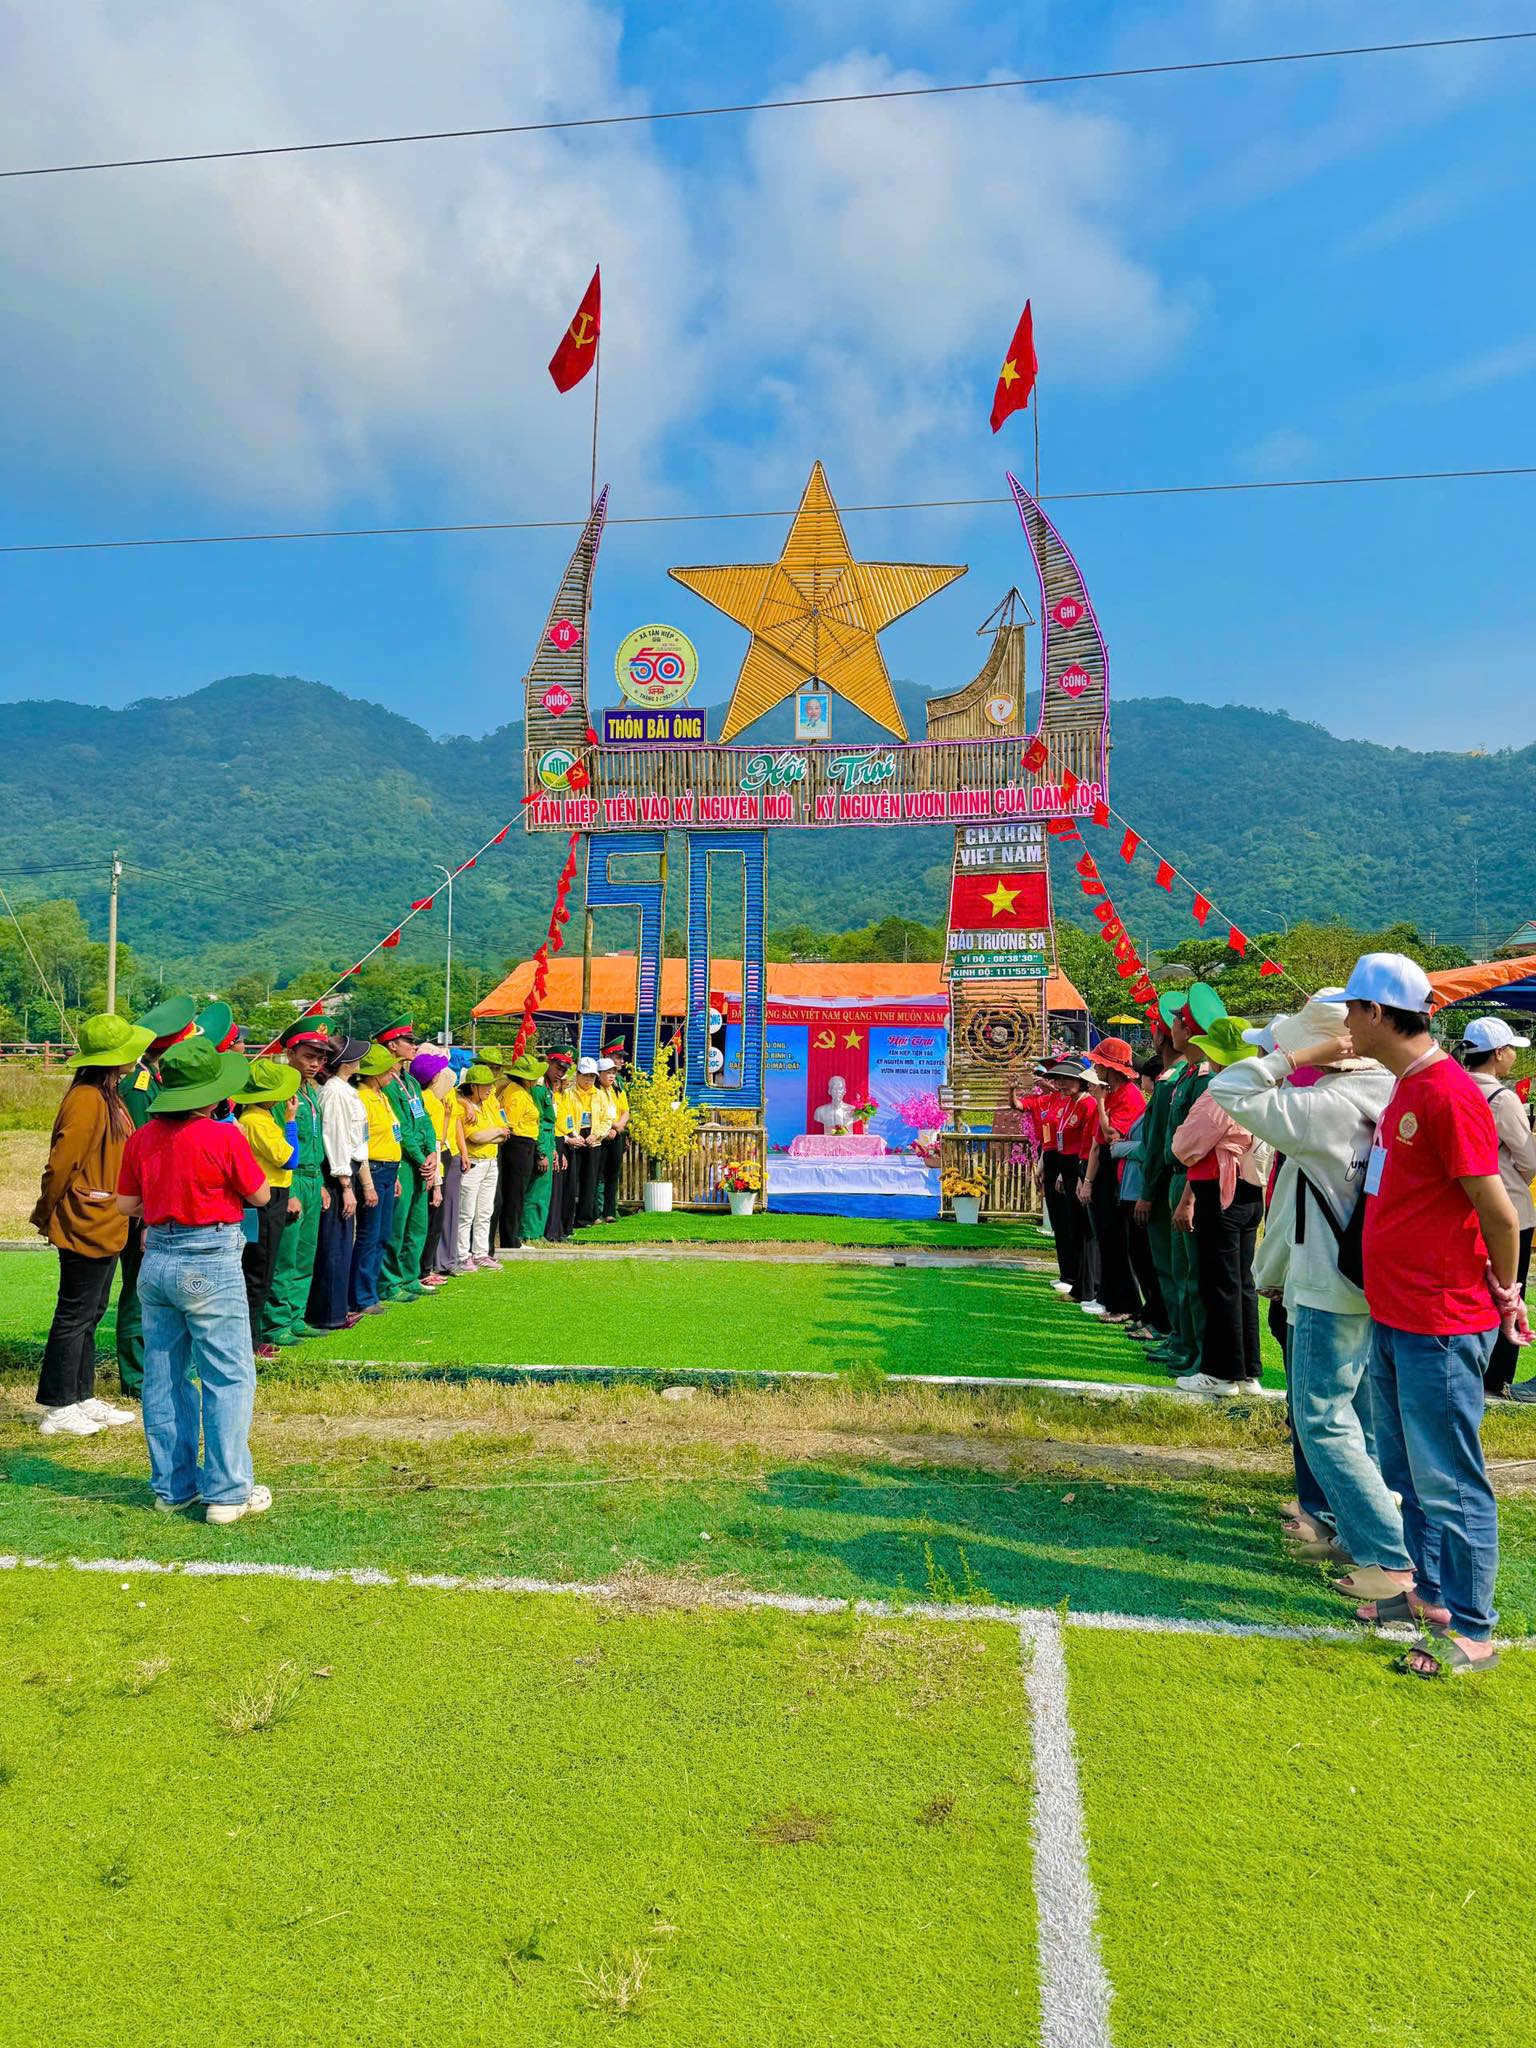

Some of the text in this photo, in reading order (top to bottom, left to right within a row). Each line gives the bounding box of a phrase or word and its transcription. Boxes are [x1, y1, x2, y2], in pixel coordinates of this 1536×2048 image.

[1060, 606, 1076, 619] GHI
[1062, 673, 1087, 688] CÔNG
[545, 690, 569, 706] QUỐC
[608, 713, 702, 739] THÔN BÃI ÔNG
[740, 747, 896, 791] Hội Trại
[532, 795, 562, 825] TÂN
[565, 794, 600, 829] HIỆP
[604, 791, 637, 822] TIẾN
[641, 792, 670, 821] VÀO
[674, 789, 694, 821] KỶ
[699, 792, 759, 821] NGUYÊN
[763, 790, 793, 820] MỚI
[816, 787, 835, 820] KỶ
[840, 789, 900, 818] NGUYÊN
[904, 791, 947, 817] VƯƠN
[950, 785, 991, 816] MÌNH
[995, 780, 1026, 814] CỦA
[1032, 781, 1066, 811] DÂN
[1071, 779, 1102, 813] TỘC
[965, 825, 1042, 845] CHXHCN
[1001, 845, 1041, 863] NAM
[950, 929, 1046, 950] ĐẢO TRƯỜNG SA
[972, 955, 985, 964] ĐỘ
[953, 969, 975, 977] KINH
[781, 1006, 799, 1019] SẢN
[800, 1008, 820, 1021] VIỆT
[821, 1010, 841, 1020] NAM
[842, 1010, 872, 1021] QUANG
[874, 1011, 895, 1021] VINH
[897, 1010, 922, 1021] MUÔN
